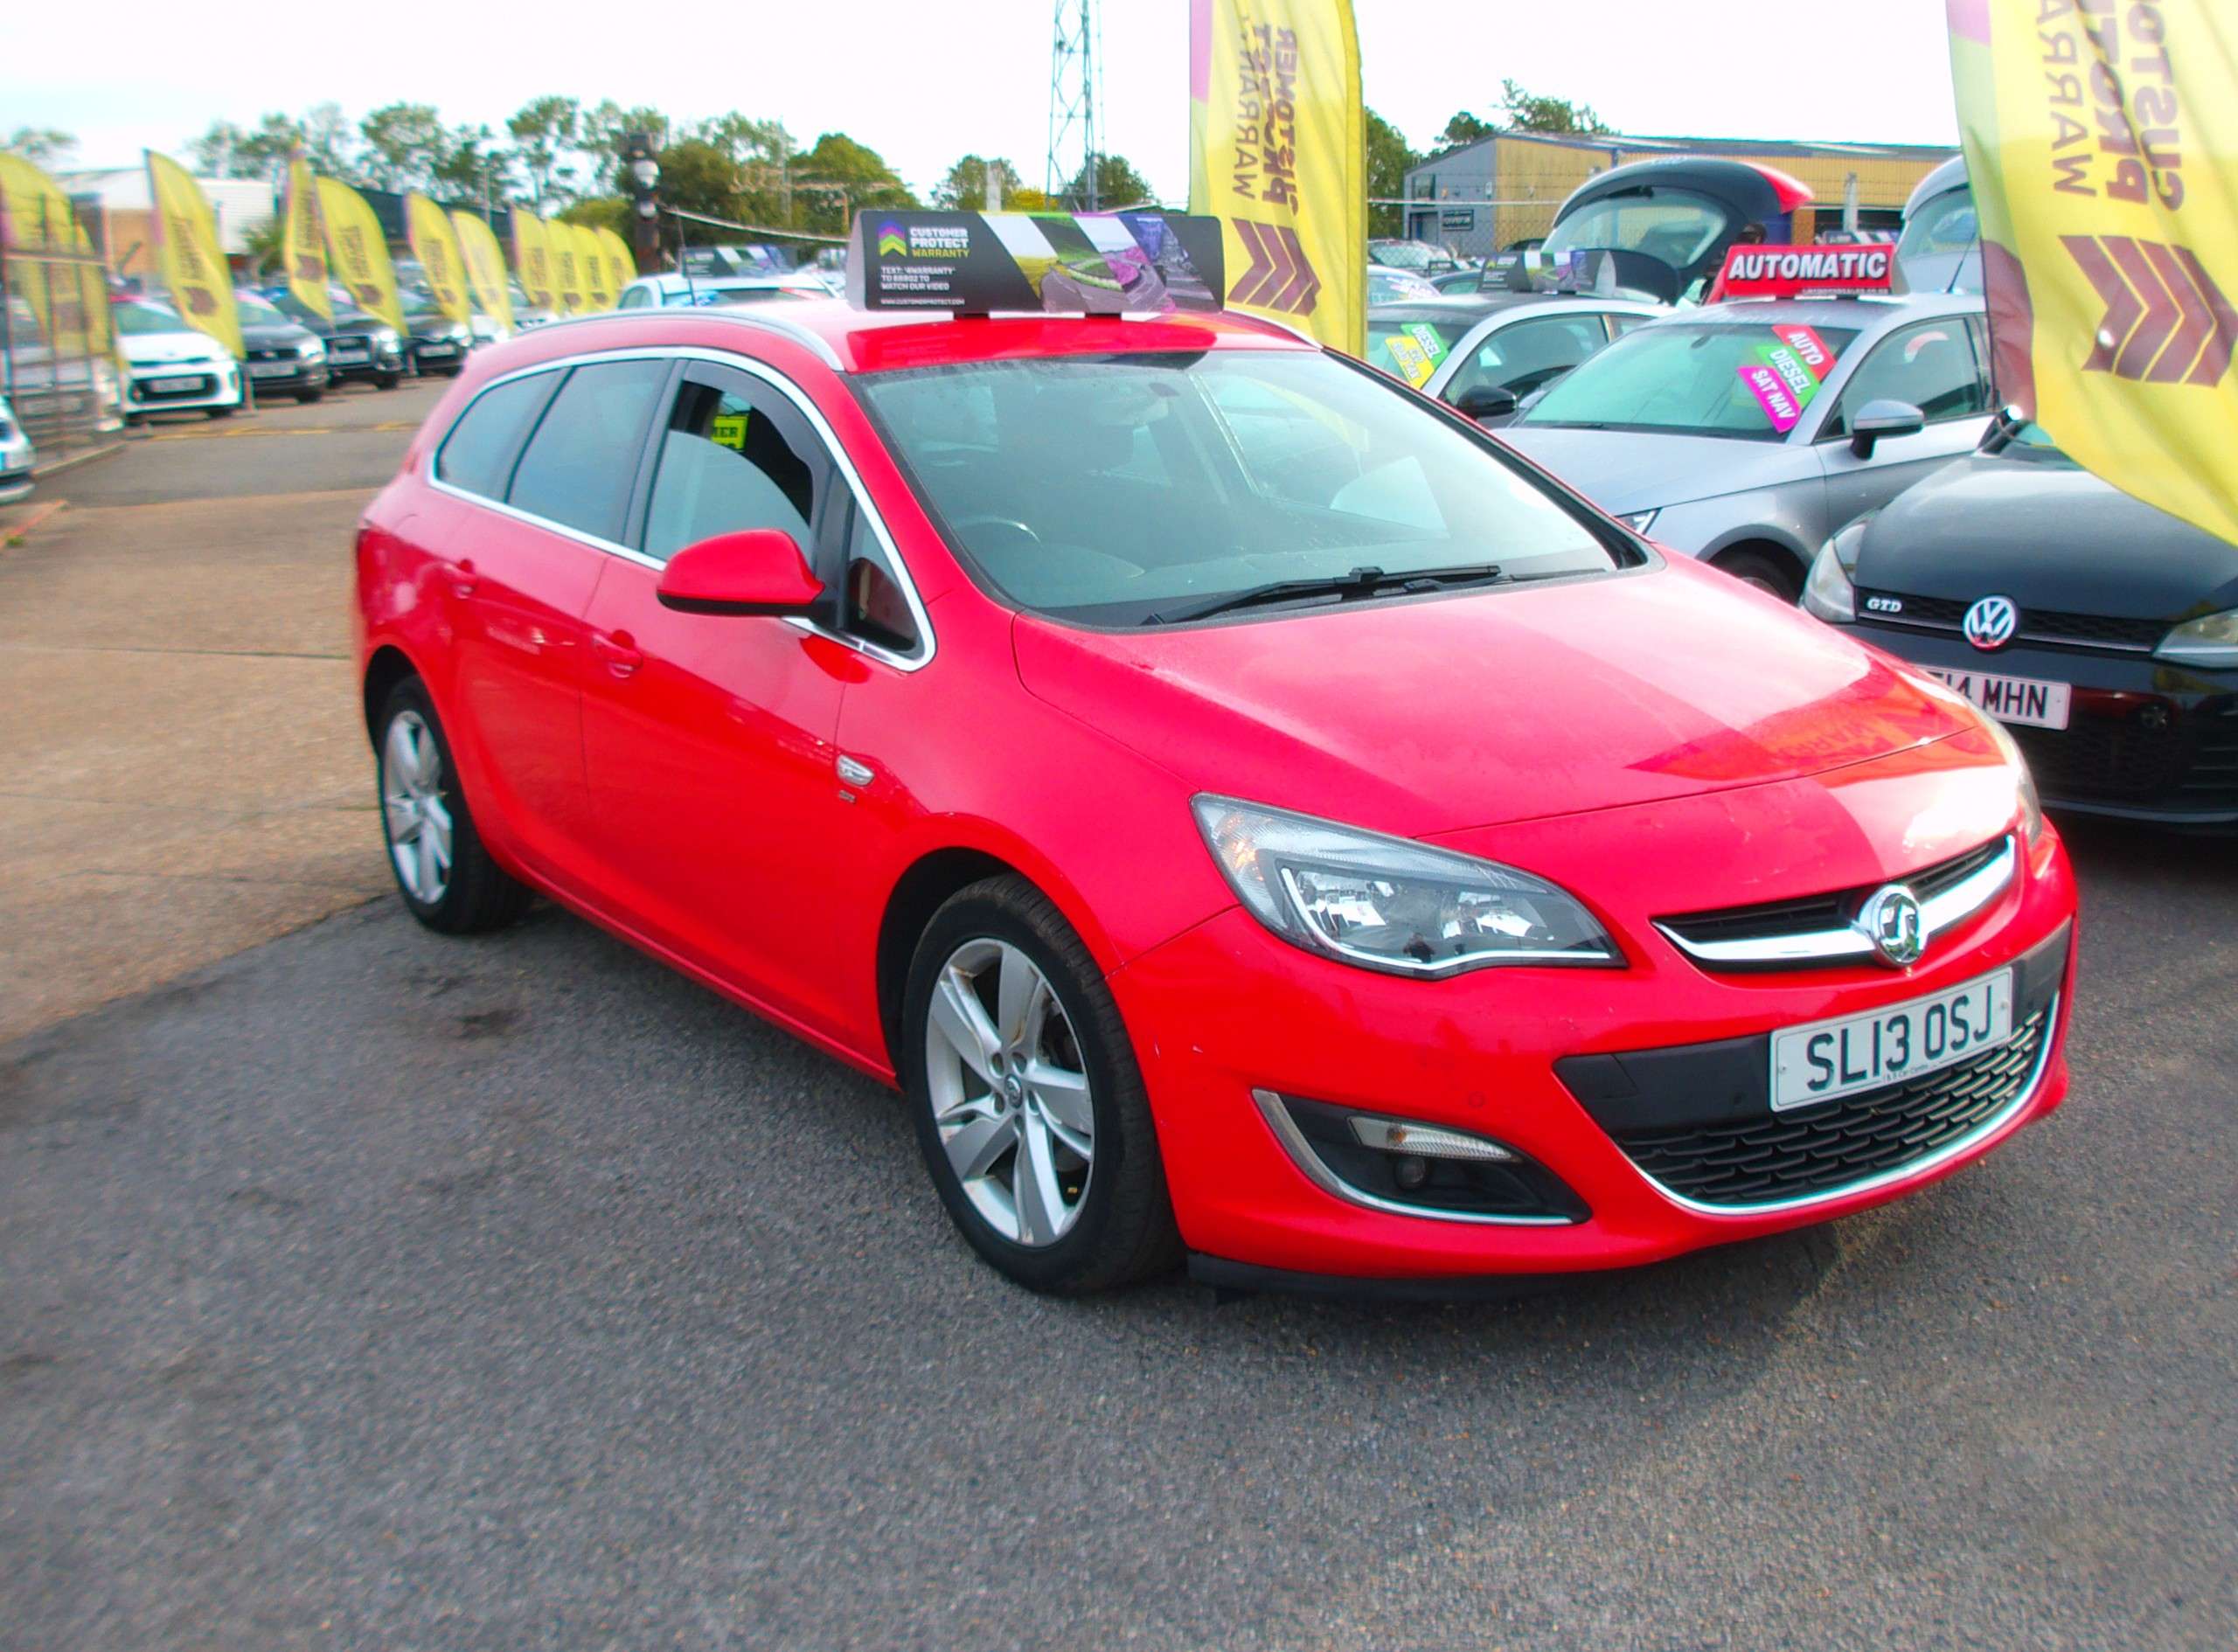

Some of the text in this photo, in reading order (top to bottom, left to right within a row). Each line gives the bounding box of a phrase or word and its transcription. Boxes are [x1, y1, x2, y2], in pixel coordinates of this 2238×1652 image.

[910, 226, 968, 237] CUSTOMER
[910, 237, 969, 248] PROTECT
[912, 248, 970, 258] WARRANTY
[1727, 252, 1887, 280] AUTOMATIC
[1787, 331, 1824, 365] AUTO
[1769, 348, 1811, 395] DIESEL
[1751, 370, 1797, 418] SAT NAV
[1866, 597, 1902, 613] GTD
[1982, 679, 2048, 719] MHN
[1807, 985, 1992, 1092] SL13 OSJ
